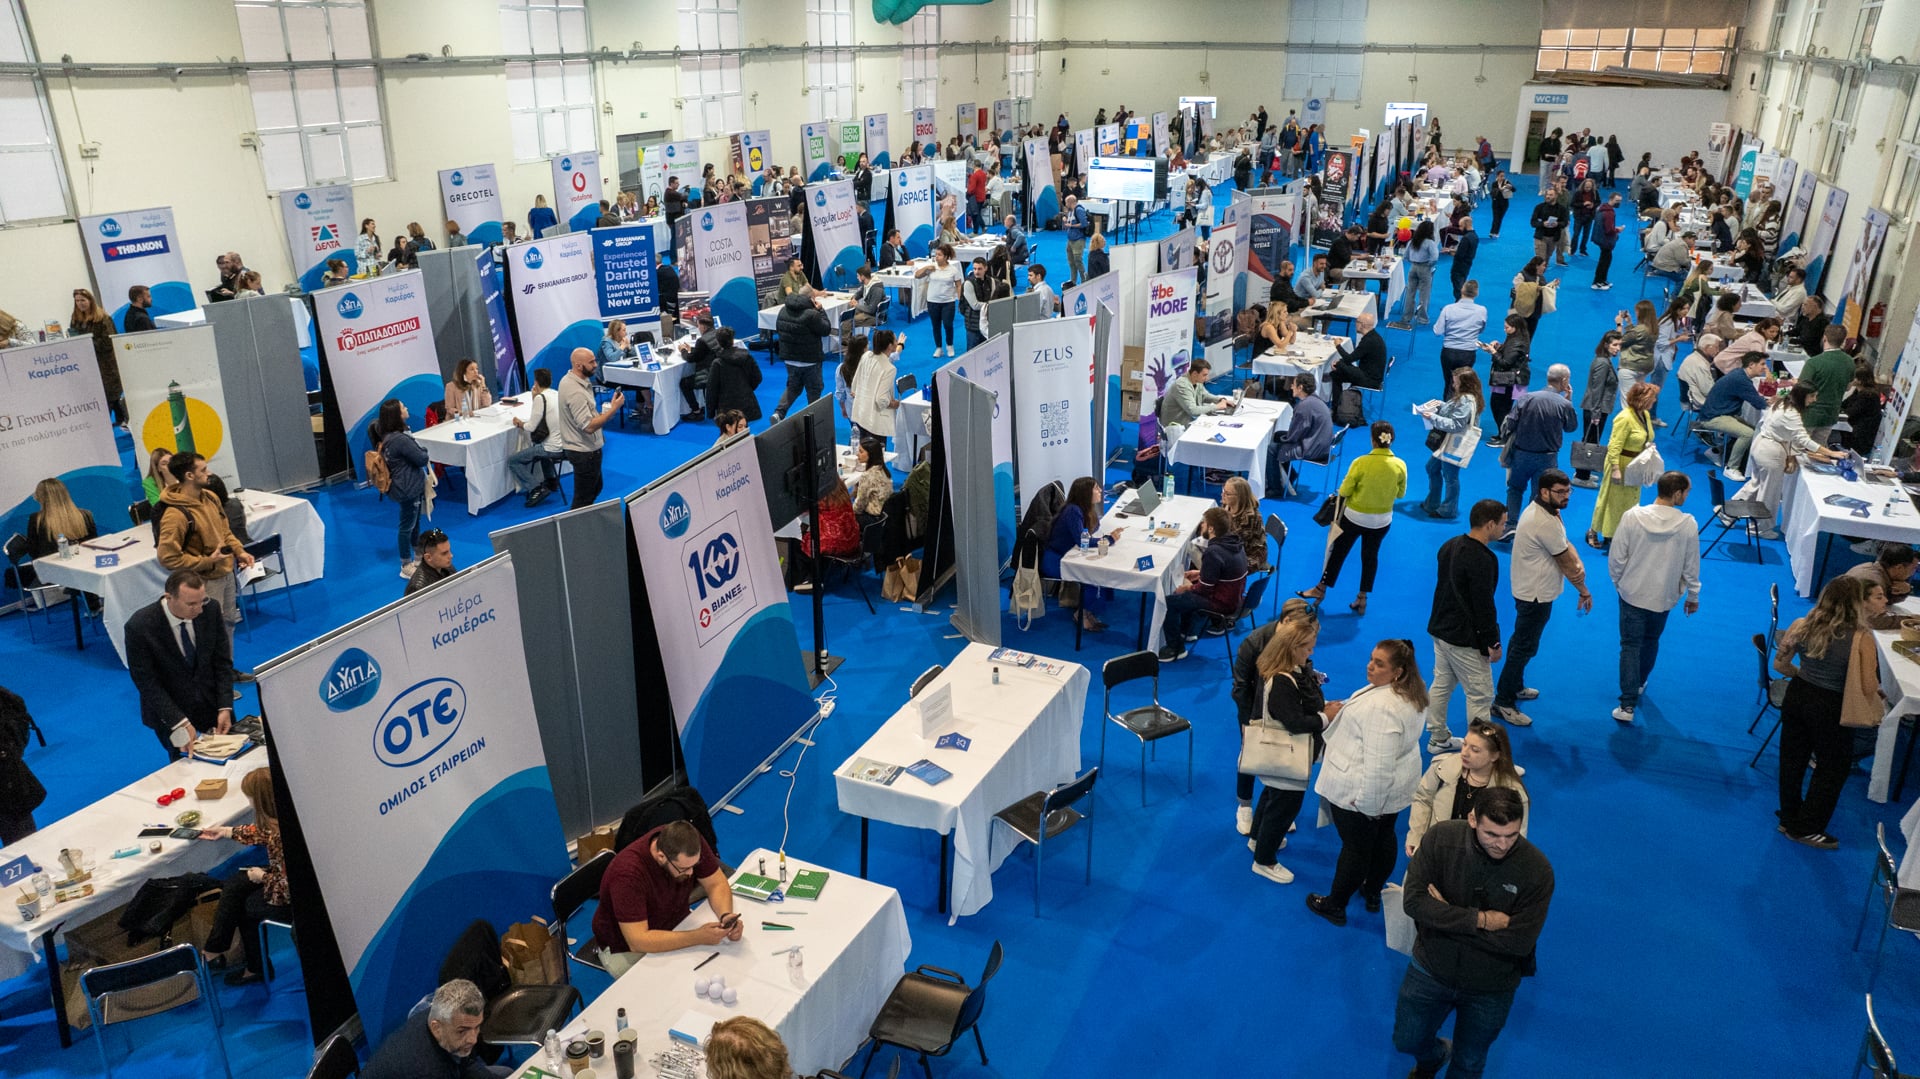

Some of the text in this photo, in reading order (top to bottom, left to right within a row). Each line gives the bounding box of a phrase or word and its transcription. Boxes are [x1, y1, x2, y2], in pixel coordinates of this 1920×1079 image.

[843, 127, 858, 135] BOX
[916, 124, 933, 136] ERGO
[810, 139, 822, 148] BOX
[811, 147, 824, 158] NOW
[450, 189, 494, 203] GRECOTEL
[571, 194, 592, 202] vodafone
[904, 189, 928, 206] SPACE
[117, 240, 164, 255] THRAKON
[315, 240, 342, 252] ΔΕΛΤΑ
[709, 237, 733, 252] COSTA
[603, 250, 647, 261] Experienced
[705, 250, 742, 268] NAVARINO
[604, 257, 648, 270] Trusted
[537, 272, 588, 290] SFAKIANAKIS GROUP
[605, 268, 649, 281] Daring
[606, 280, 650, 291] Innovative
[1151, 283, 1174, 300] #be
[384, 291, 415, 304] Καριέρας
[607, 291, 623, 299] Lead
[607, 295, 651, 308] New Era
[1150, 297, 1188, 318] MORE
[33, 352, 69, 366] Ημέρα
[1032, 345, 1073, 363] ZEUS
[28, 362, 80, 379] Καριέρας
[16, 409, 57, 428] Γενική
[57, 398, 101, 418] Κλινική
[28, 427, 68, 442] πολύτιμο
[716, 461, 742, 481] Ημέρα
[715, 473, 751, 501] Καριέρας
[101, 557, 114, 566] 52
[1141, 559, 1151, 569] 24
[711, 583, 743, 612] ΒΙΑΝΕΞ
[438, 592, 483, 624] Ημέρα
[431, 608, 496, 650] Καριέρας
[379, 736, 487, 816] ΟΜΙΛΟΣ ΕΤΑΙΡΕΙΩΝ
[4, 863, 22, 880] 27
